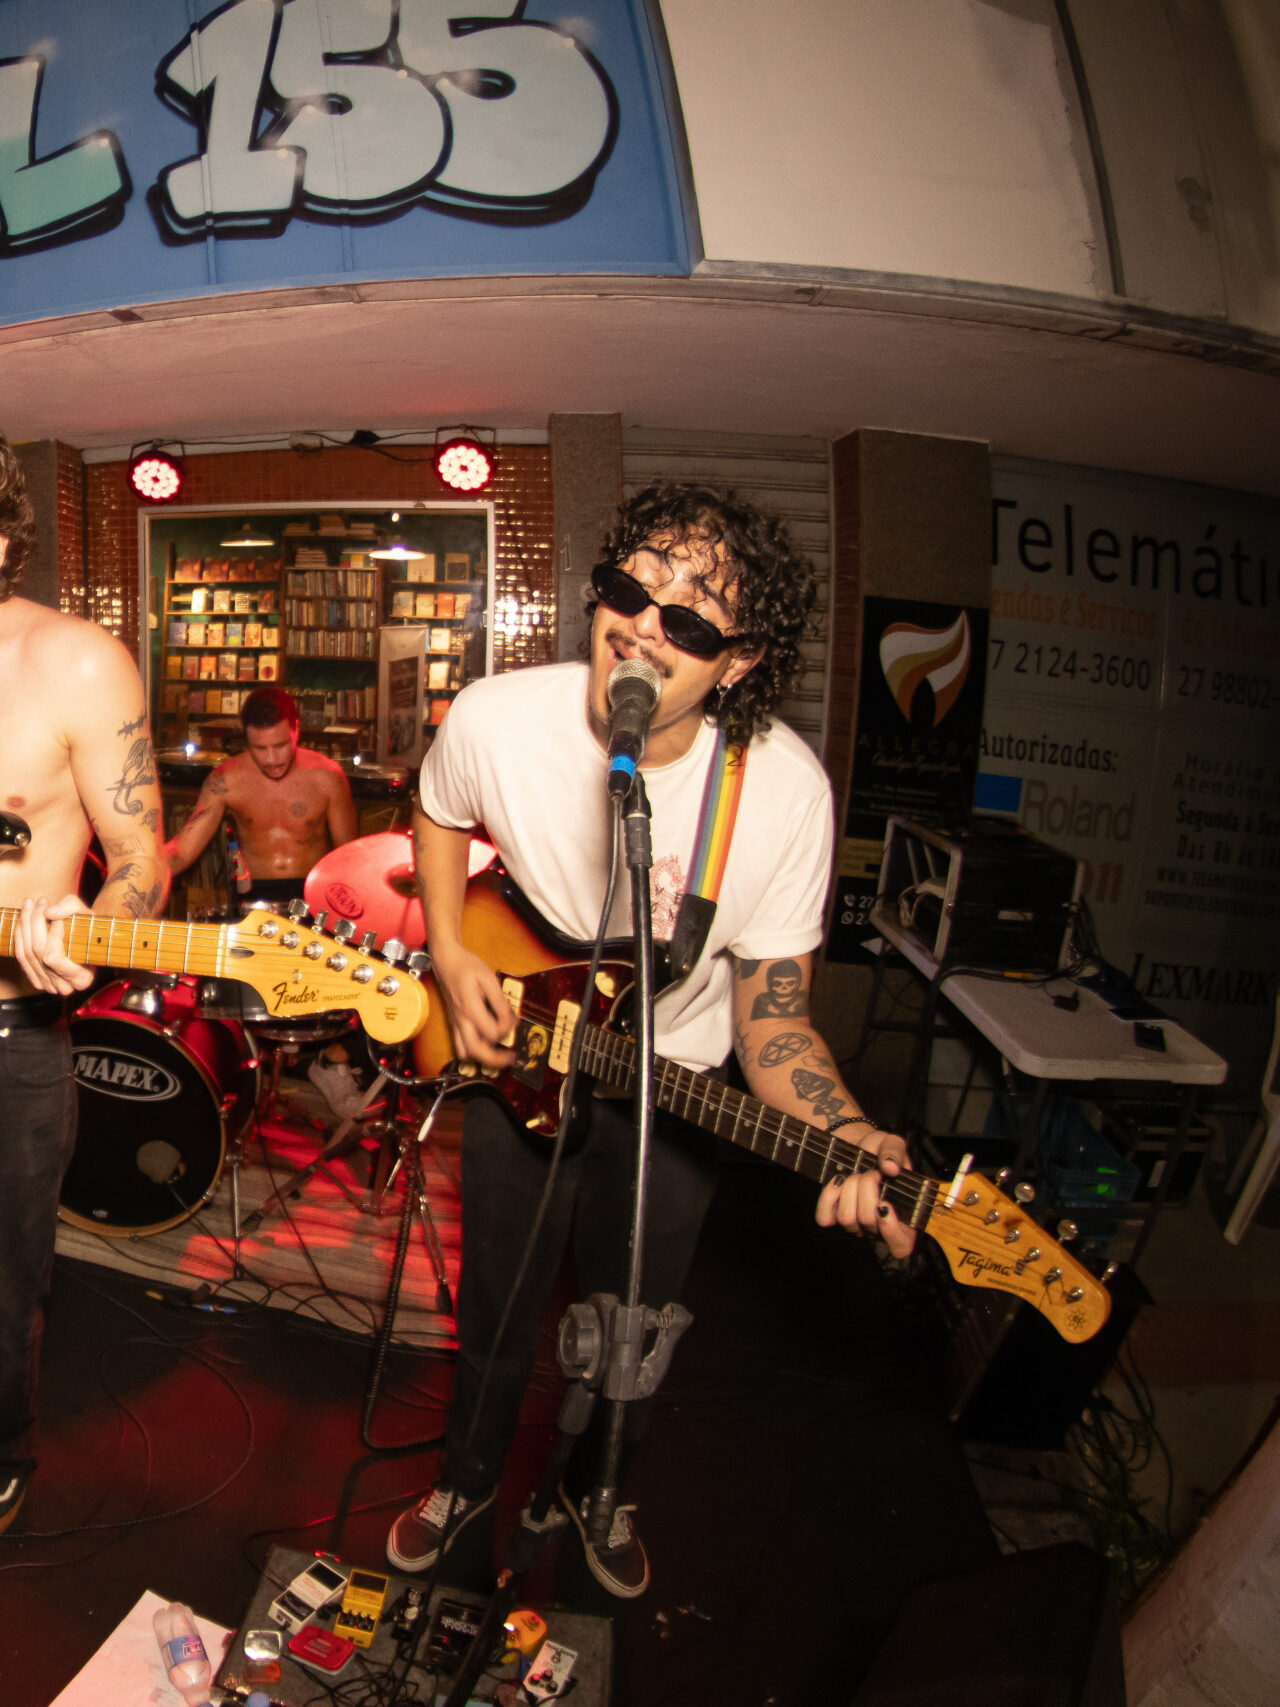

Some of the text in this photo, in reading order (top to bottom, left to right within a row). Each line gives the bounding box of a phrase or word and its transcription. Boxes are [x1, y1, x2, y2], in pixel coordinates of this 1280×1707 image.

[147, 0, 620, 247] 155
[991, 497, 1280, 608] Telemáti
[990, 582, 1054, 625] endas
[989, 639, 1005, 670] 7
[1014, 642, 1151, 691] 2124-3600
[1178, 665, 1205, 697] 27
[1022, 778, 1137, 843] Roland
[1176, 800, 1239, 833] Segunda
[272, 981, 320, 1012] Fender
[73, 1054, 158, 1092] MAPEX
[958, 1247, 1013, 1279] Tagima
